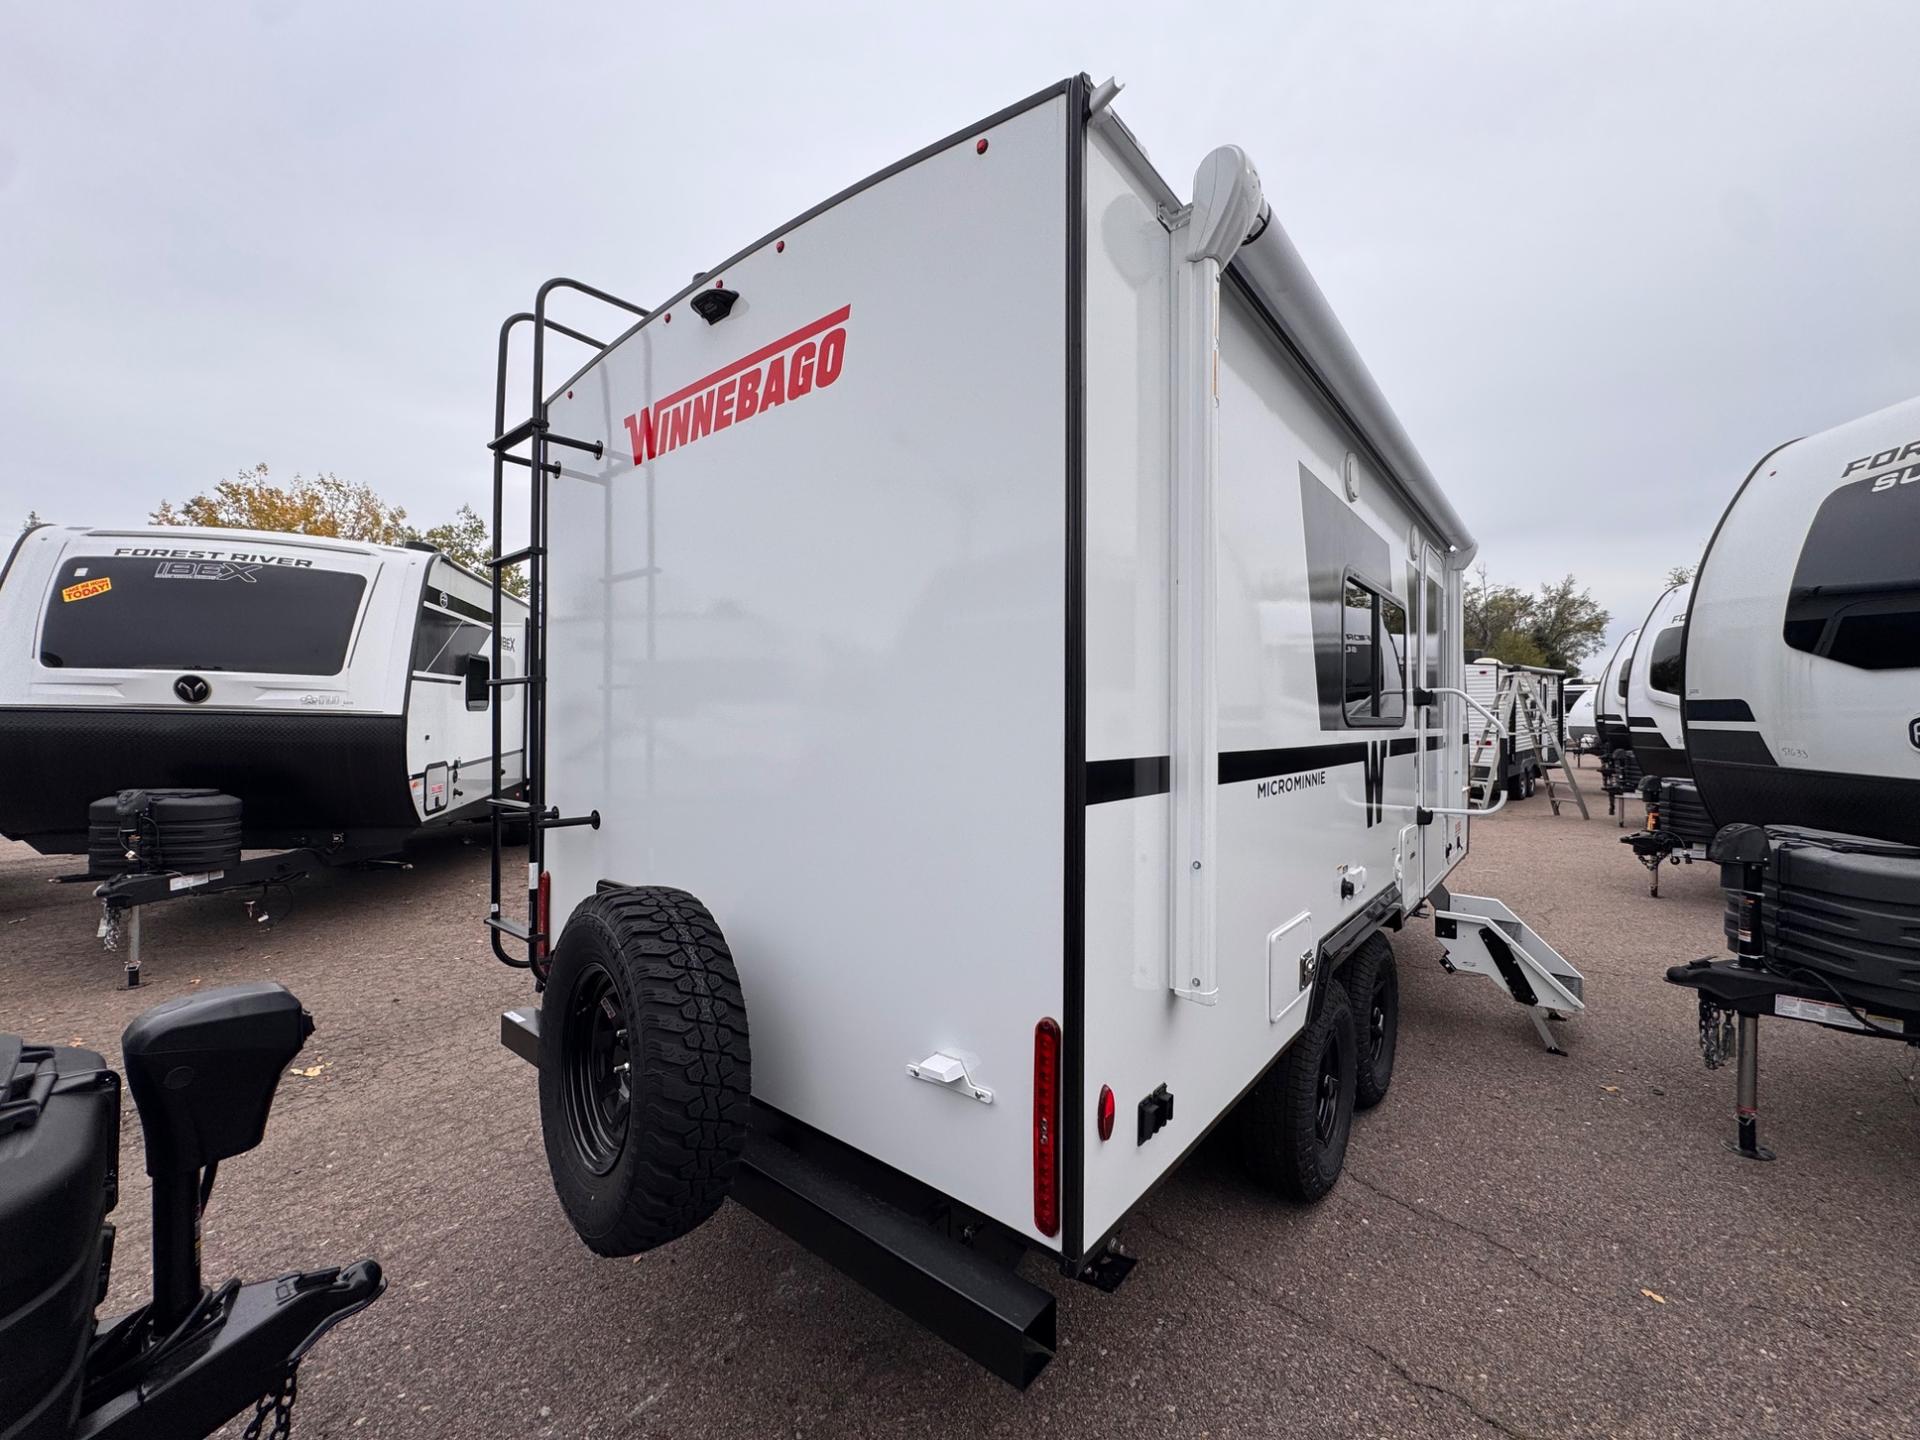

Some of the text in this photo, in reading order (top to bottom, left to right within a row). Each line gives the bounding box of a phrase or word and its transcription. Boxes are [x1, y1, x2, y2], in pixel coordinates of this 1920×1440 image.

[623, 325, 848, 467] WINNEBAGO
[113, 548, 313, 568] FOREST RIVER
[154, 561, 263, 583] IBEX
[65, 582, 110, 600] TODAY!
[1257, 770, 1326, 799] MICROMINNIE
